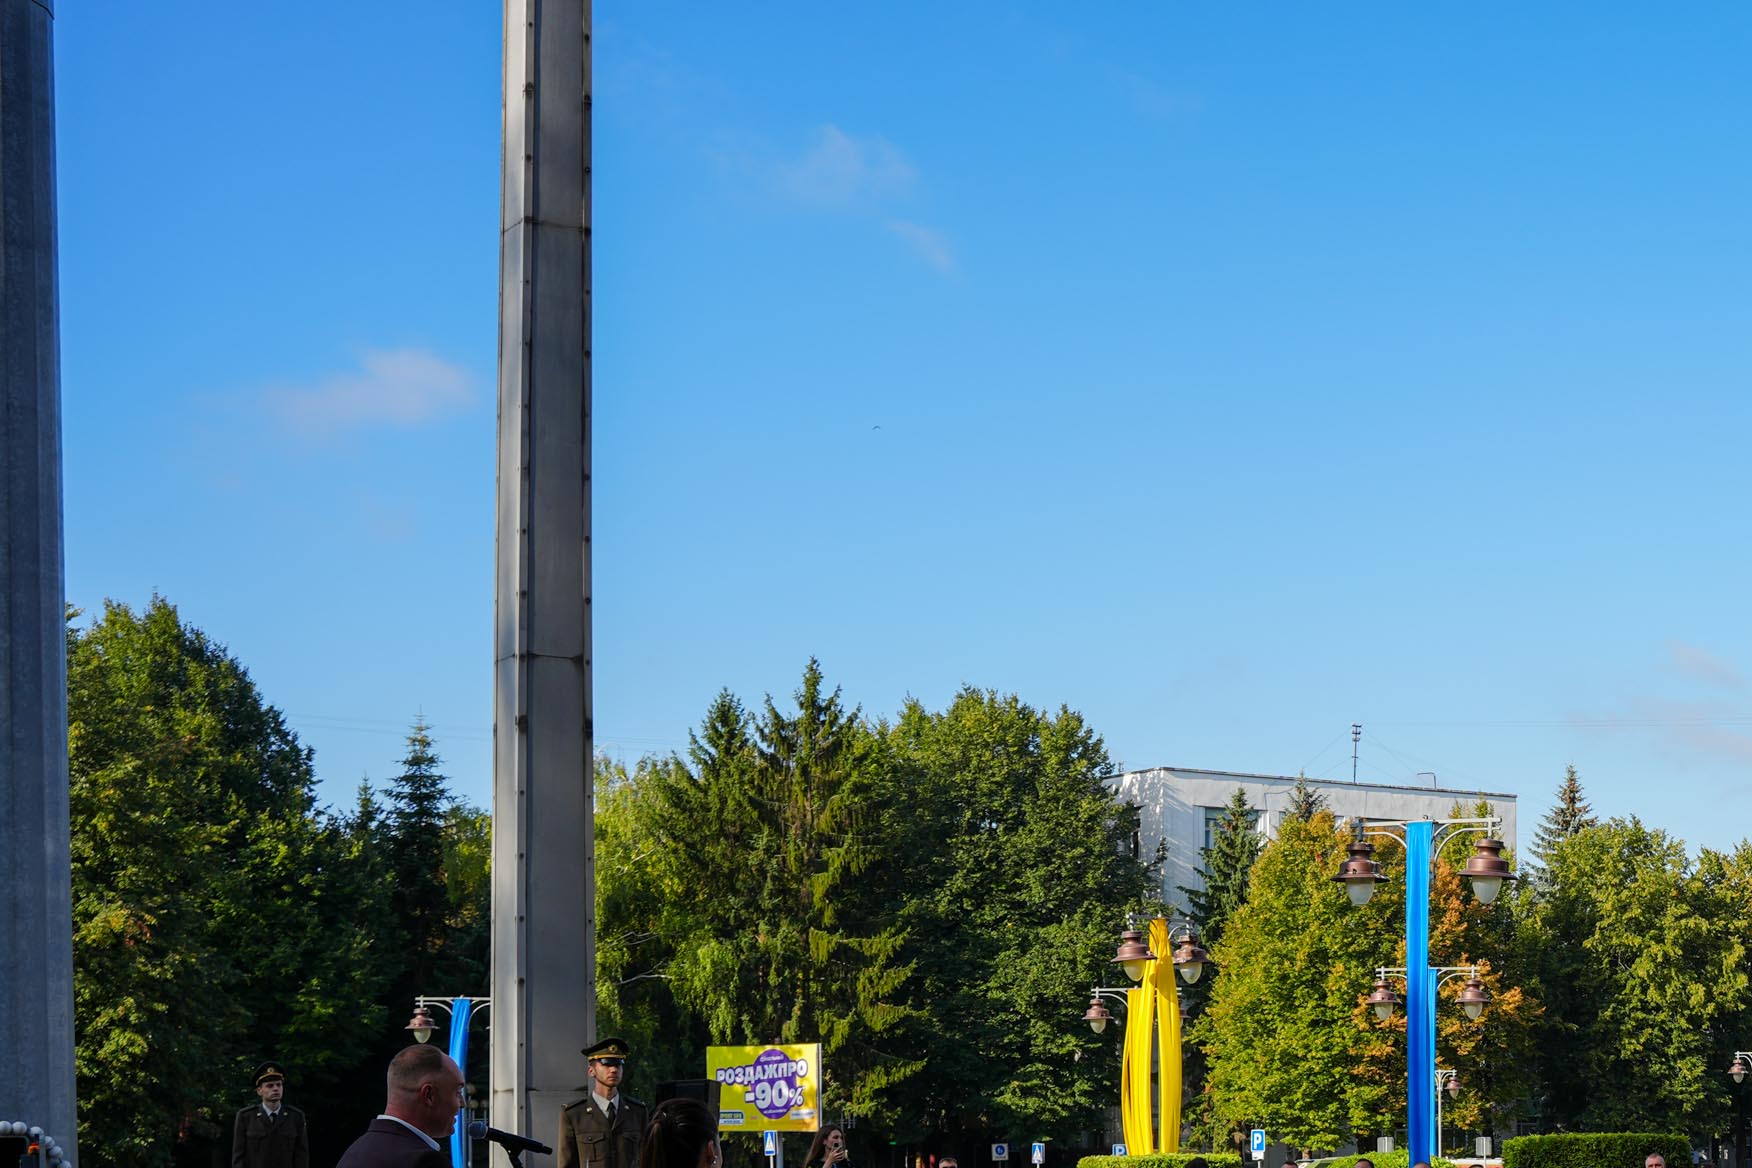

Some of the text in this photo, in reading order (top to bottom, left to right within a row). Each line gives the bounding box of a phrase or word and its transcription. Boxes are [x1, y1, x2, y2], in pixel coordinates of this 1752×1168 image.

[716, 1059, 808, 1085] РОЗДАЖПРО
[745, 1080, 804, 1109] -90%
[1253, 1133, 1262, 1149] P
